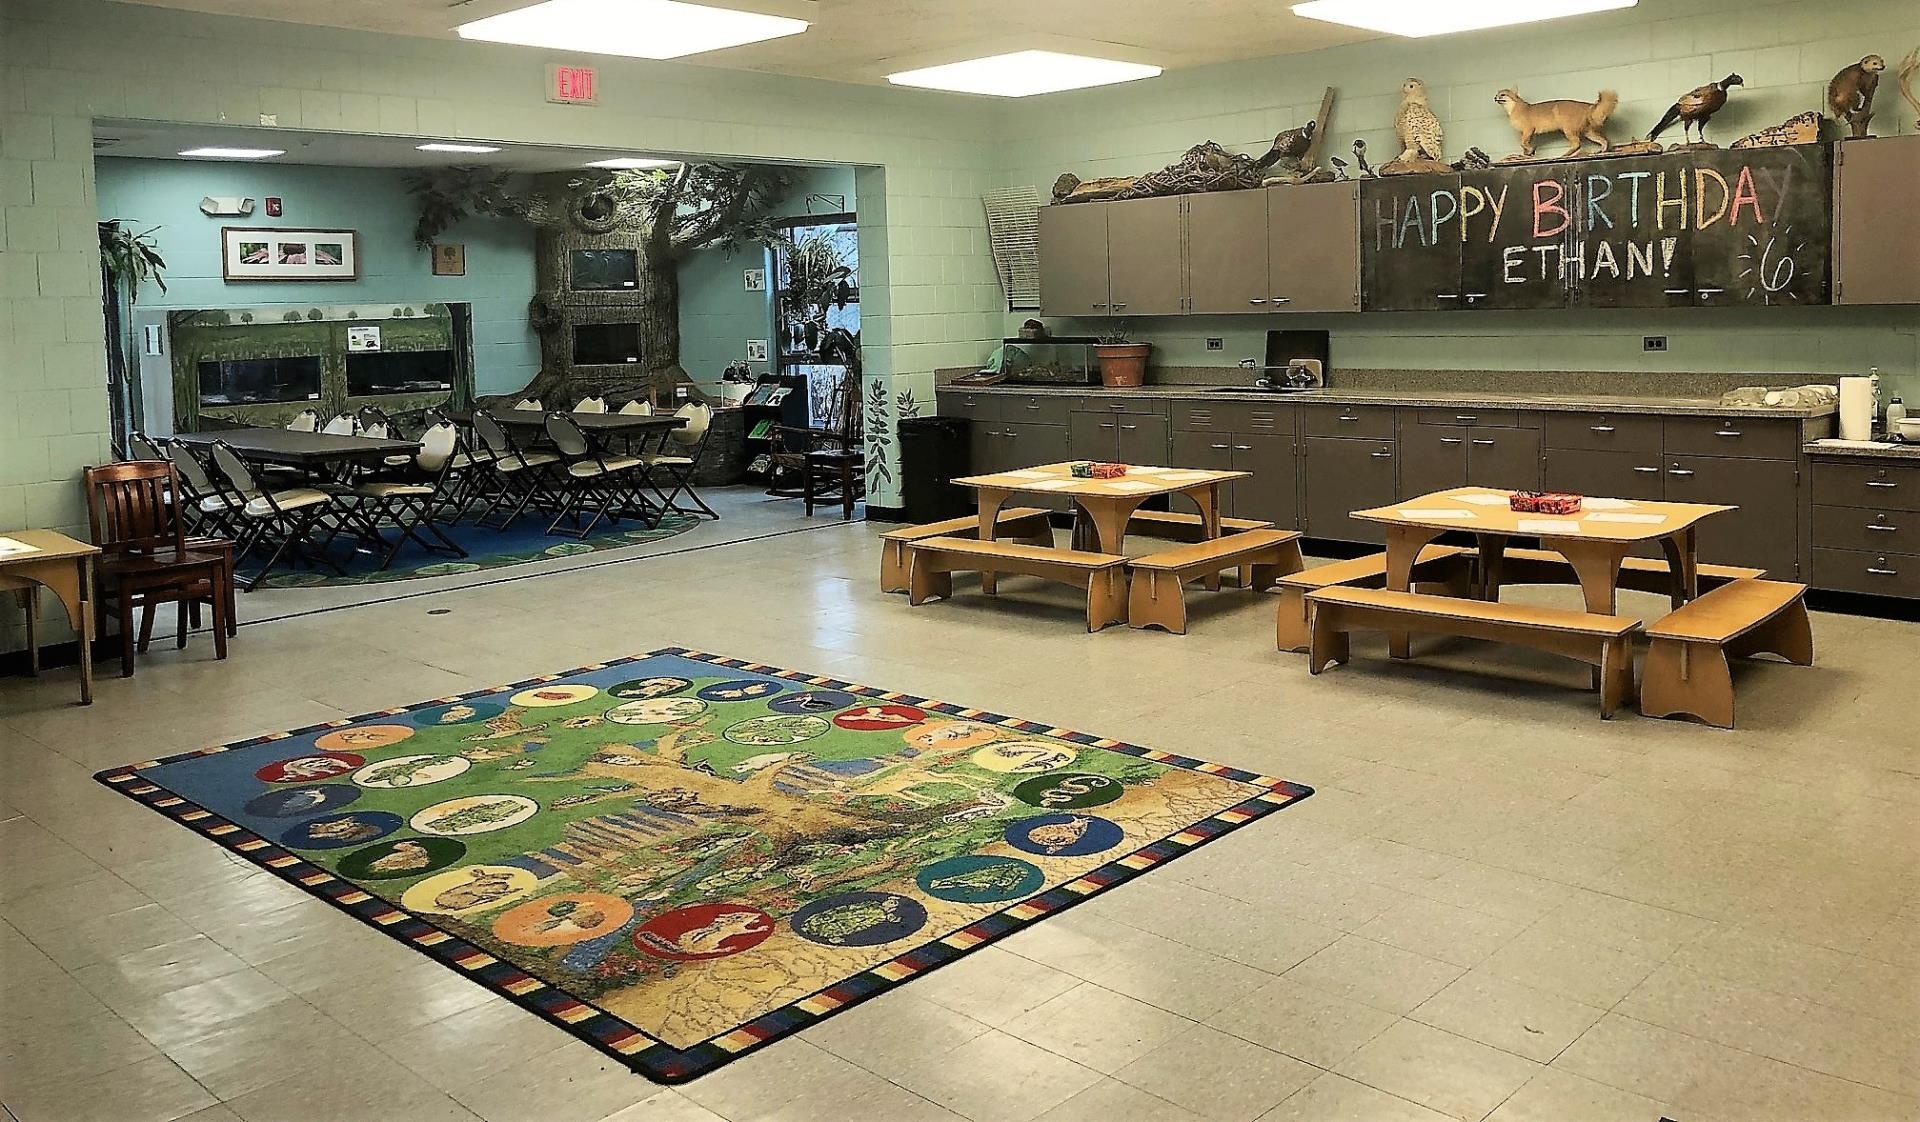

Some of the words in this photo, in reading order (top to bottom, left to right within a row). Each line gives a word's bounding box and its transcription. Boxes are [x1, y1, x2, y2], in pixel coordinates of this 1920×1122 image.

[559, 67, 593, 99] EXIT
[1375, 184, 1508, 251] HAPPY
[1532, 164, 1792, 238] BIRTHDAY
[1502, 237, 1678, 284] ETHAN!
[1759, 237, 1795, 291] 6
